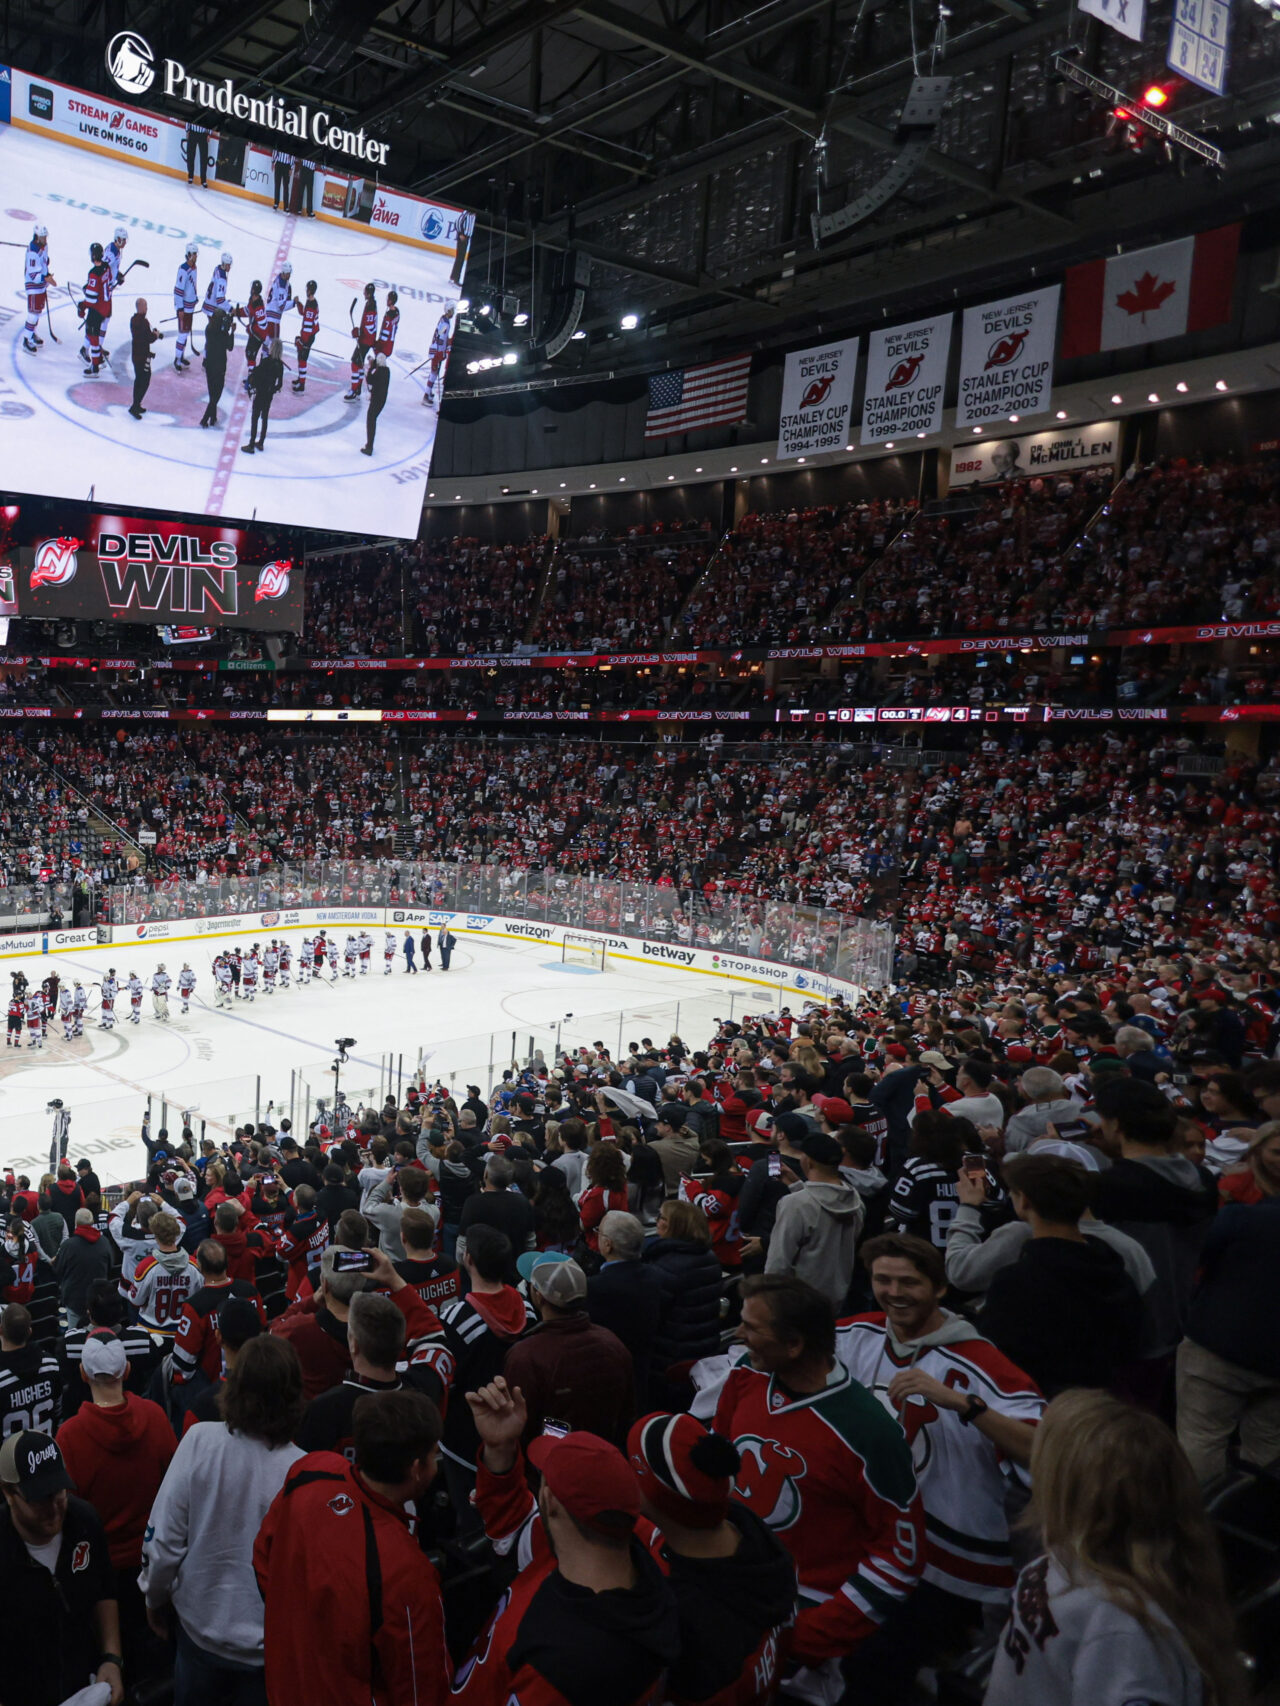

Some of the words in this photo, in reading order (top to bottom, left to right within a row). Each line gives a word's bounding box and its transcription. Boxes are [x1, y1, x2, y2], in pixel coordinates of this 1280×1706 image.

[68, 99, 109, 122] STREAM
[125, 119, 158, 138] GAMES
[163, 57, 309, 140] Prudential
[313, 111, 391, 166] Center
[79, 122, 99, 137] LIVE
[101, 130, 114, 142] ON
[115, 134, 134, 148] MSG
[135, 141, 148, 152] GO
[982, 308, 1002, 321] NEW
[1003, 300, 1039, 316] JERSEY
[984, 313, 1033, 334] DEVILS
[884, 333, 903, 345] NEW
[904, 326, 935, 341] JERSEY
[799, 355, 816, 366] NEW
[816, 350, 843, 363] JERSEY
[887, 338, 929, 357] DEVILS
[800, 360, 839, 378] DEVILS
[962, 367, 1019, 392] STANLEY
[1021, 361, 1050, 380] CUP
[865, 389, 915, 412] STANLEY
[917, 385, 942, 402] CUP
[964, 379, 1044, 407] CHAMPIONS
[781, 408, 823, 429] STANLEY
[826, 404, 849, 420] CUP
[867, 402, 935, 426] CHAMPIONS
[966, 396, 1039, 420] 2002-2003
[782, 420, 844, 442] CHAMPIONS
[869, 417, 932, 438] 1999-2000
[785, 435, 840, 453] 1994-1995
[1029, 444, 1045, 454] DR.
[1047, 440, 1072, 451] JOHN
[1029, 441, 1112, 465] McMULLEN
[955, 460, 983, 474] 1982
[97, 532, 238, 568] DEVILS
[98, 561, 239, 615] WIN
[767, 647, 822, 658] DEVILS
[825, 645, 865, 657] WIN!
[960, 638, 1033, 650] DEVILS
[1038, 634, 1089, 647] WIN!
[234, 660, 268, 671] Citizens
[841, 711, 849, 720] 0
[882, 711, 905, 719] 00.0
[954, 710, 965, 720] 4
[327, 912, 360, 920] AMSTERDAM
[361, 912, 377, 920] VODKA
[429, 913, 450, 925] SAP
[467, 917, 489, 928] SAP
[55, 933, 86, 944] Great
[148, 923, 169, 934] pepsi
[505, 922, 551, 938] verizon
[643, 942, 696, 965] betway
[721, 959, 788, 980] STOP&SHOP
[811, 979, 854, 1002] Prudential
[308, 1221, 329, 1249] HUGHES
[156, 1274, 191, 1288] HUGHES
[154, 1288, 189, 1323] 86
[944, 1368, 970, 1395] C
[9, 1380, 53, 1409] HUGHES
[27, 1443, 59, 1475] Jersey
[893, 1519, 917, 1567] 9
